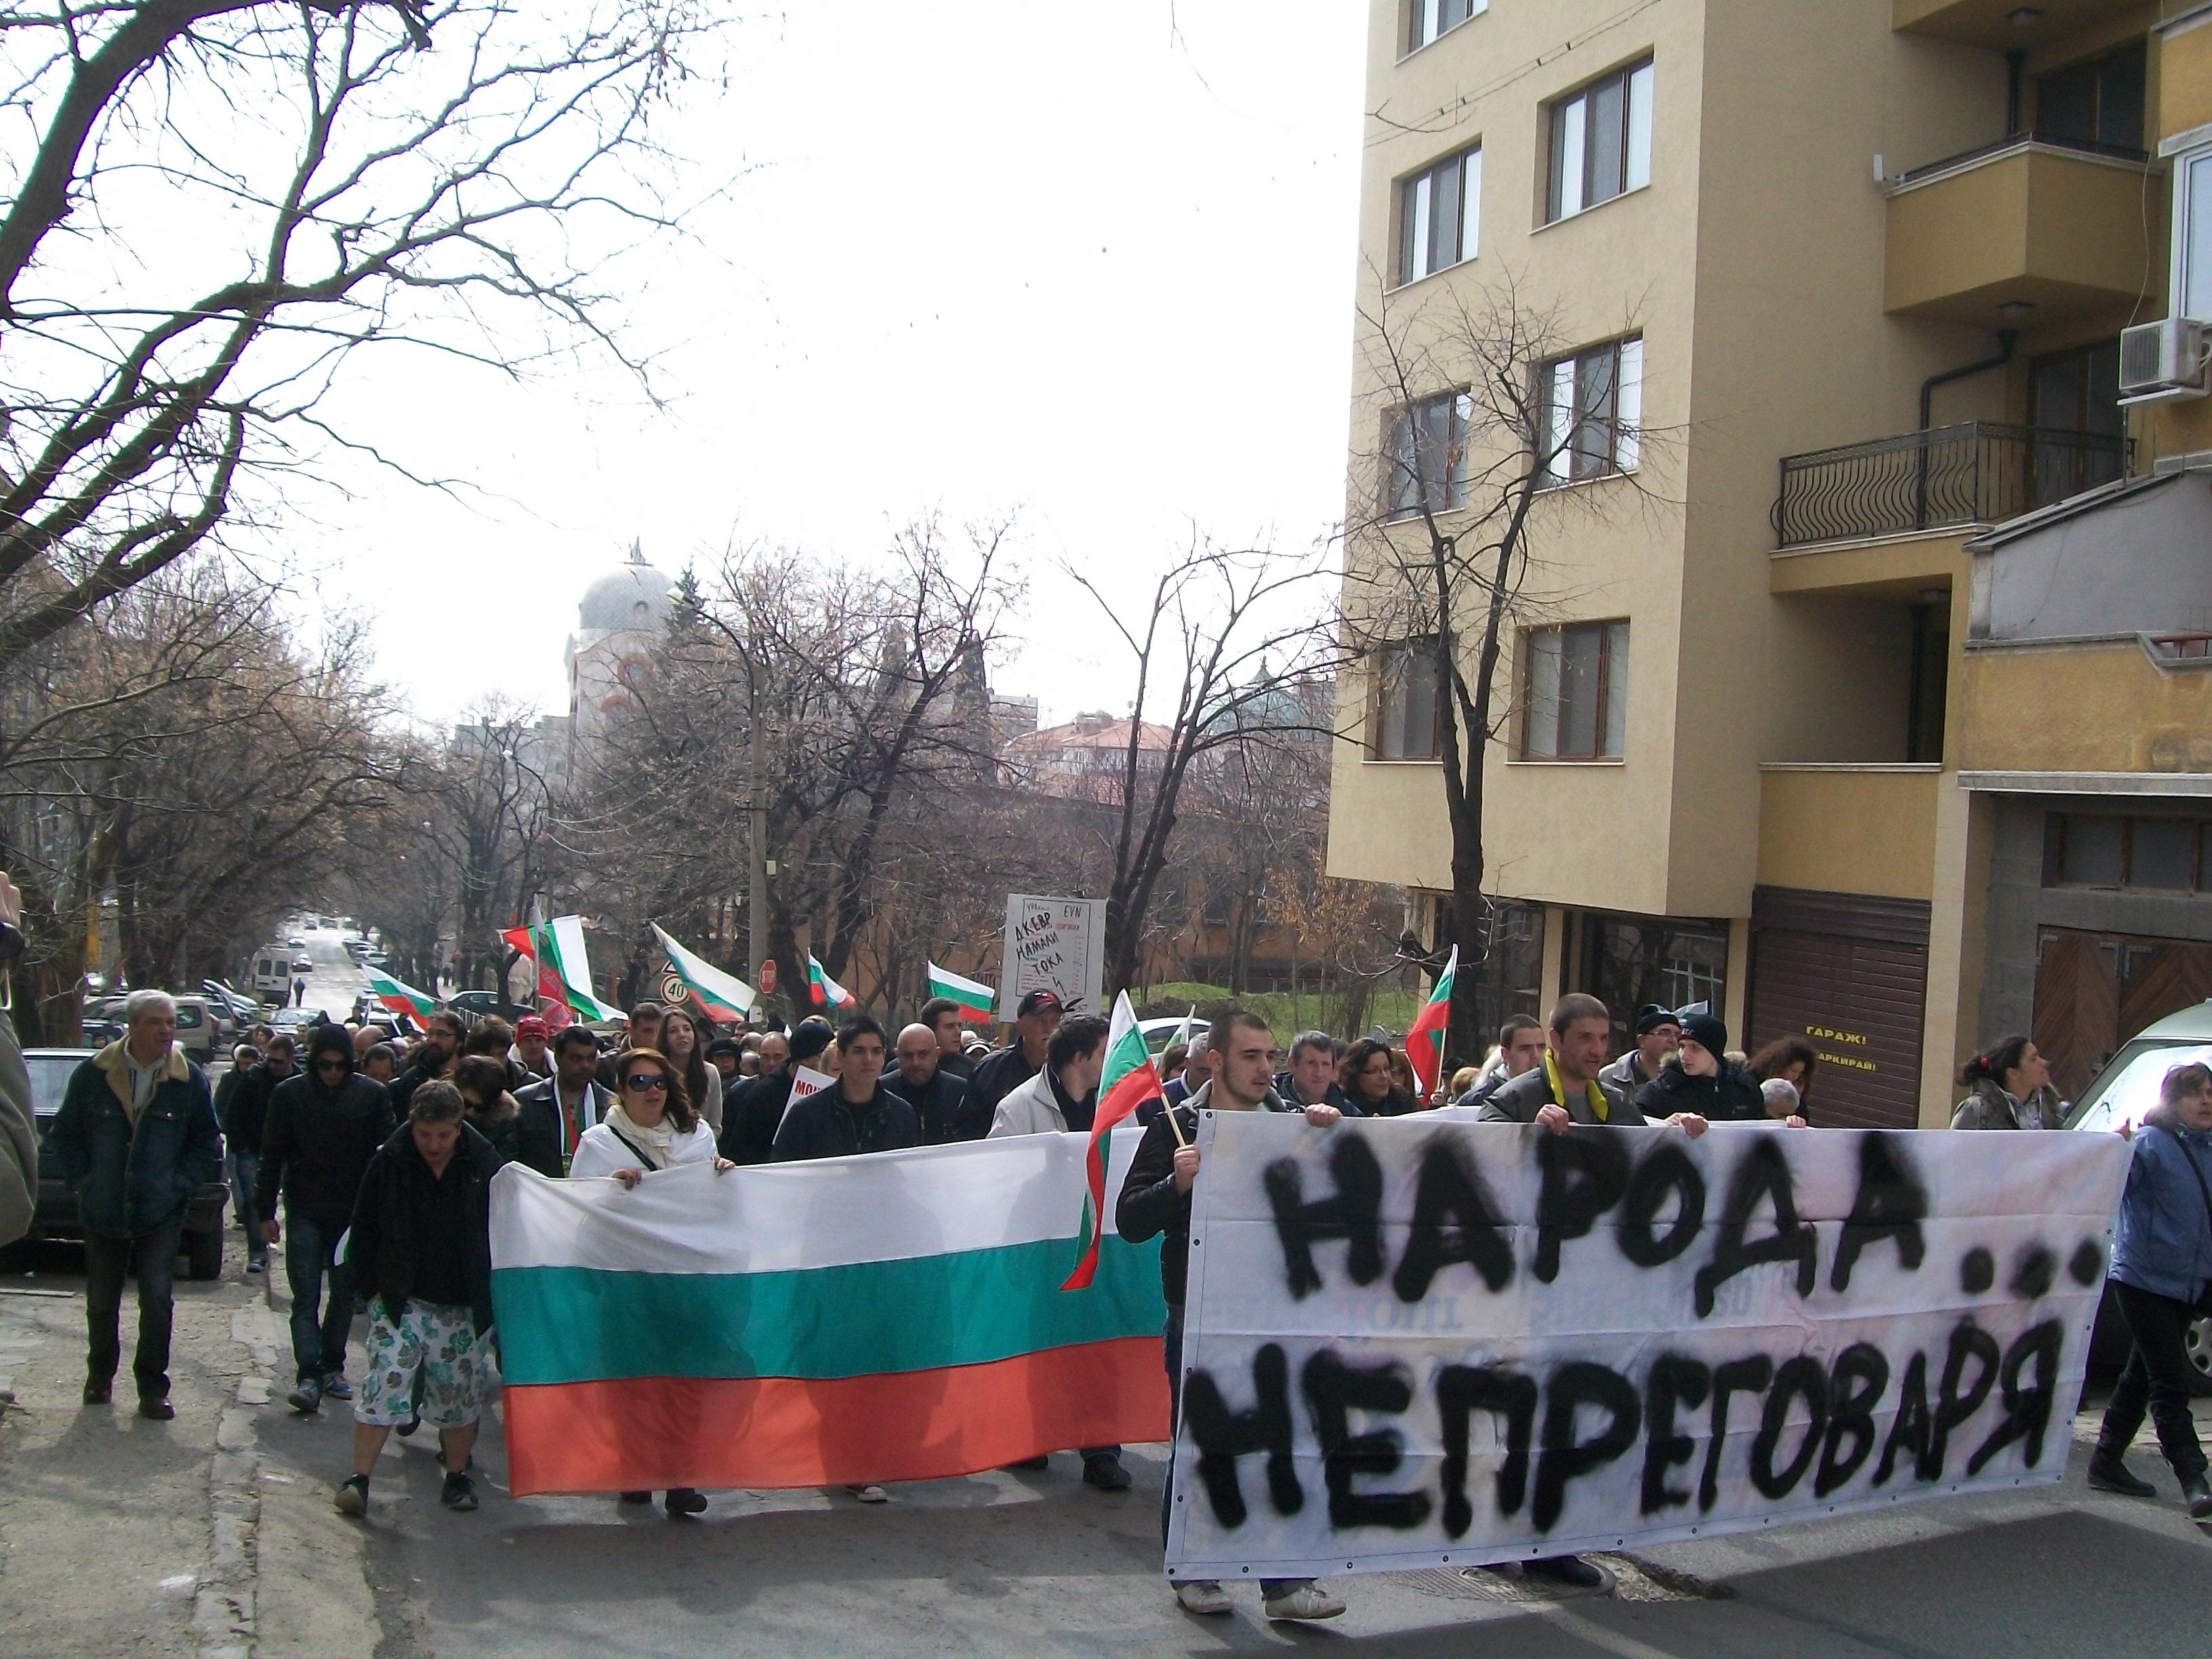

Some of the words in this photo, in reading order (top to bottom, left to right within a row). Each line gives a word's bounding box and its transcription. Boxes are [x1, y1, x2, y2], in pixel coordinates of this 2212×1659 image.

[1063, 905, 1082, 918] EVN
[1016, 931, 1060, 961] НАМАЛИ
[1031, 952, 1064, 977] ТОКА
[668, 982, 684, 998] 40
[1805, 1025, 1868, 1046] ГАРАЖ!
[1816, 1051, 1877, 1072] АРКИРАЙ!
